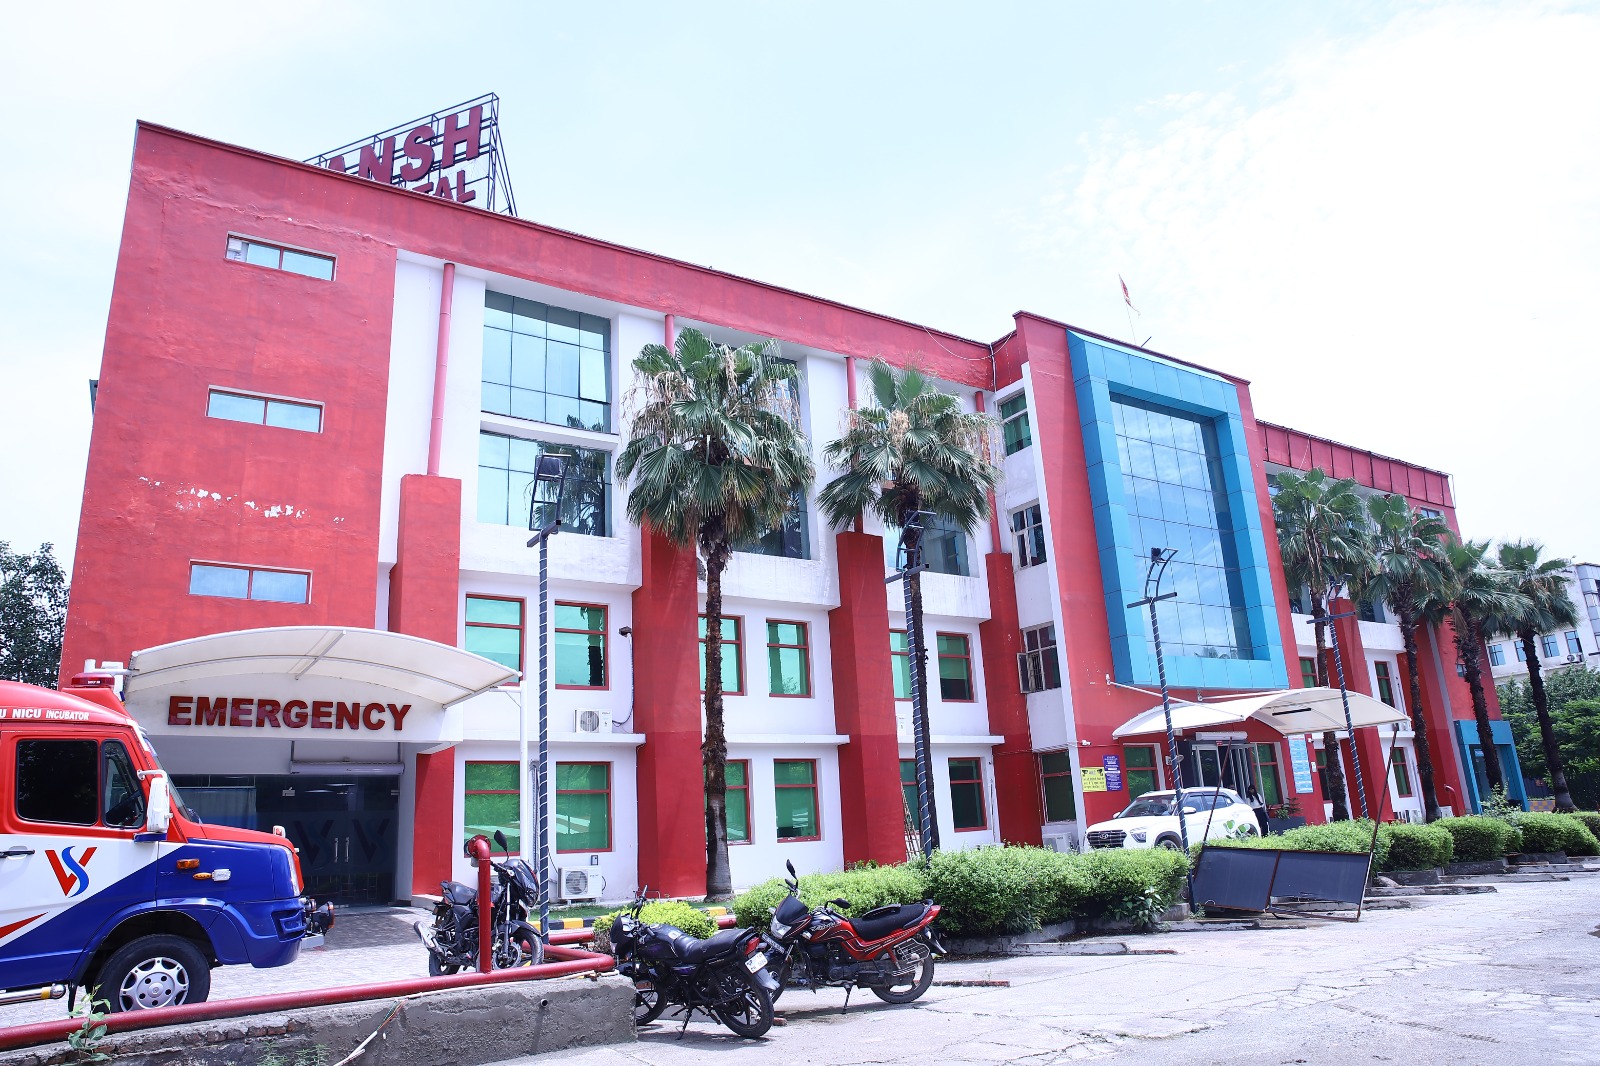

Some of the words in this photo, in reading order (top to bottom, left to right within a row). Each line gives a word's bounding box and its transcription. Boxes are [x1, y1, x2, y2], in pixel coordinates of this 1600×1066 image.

[12, 708, 42, 719] NICU
[45, 709, 90, 720] INCUBATOR
[168, 695, 412, 731] EMERGENCY
